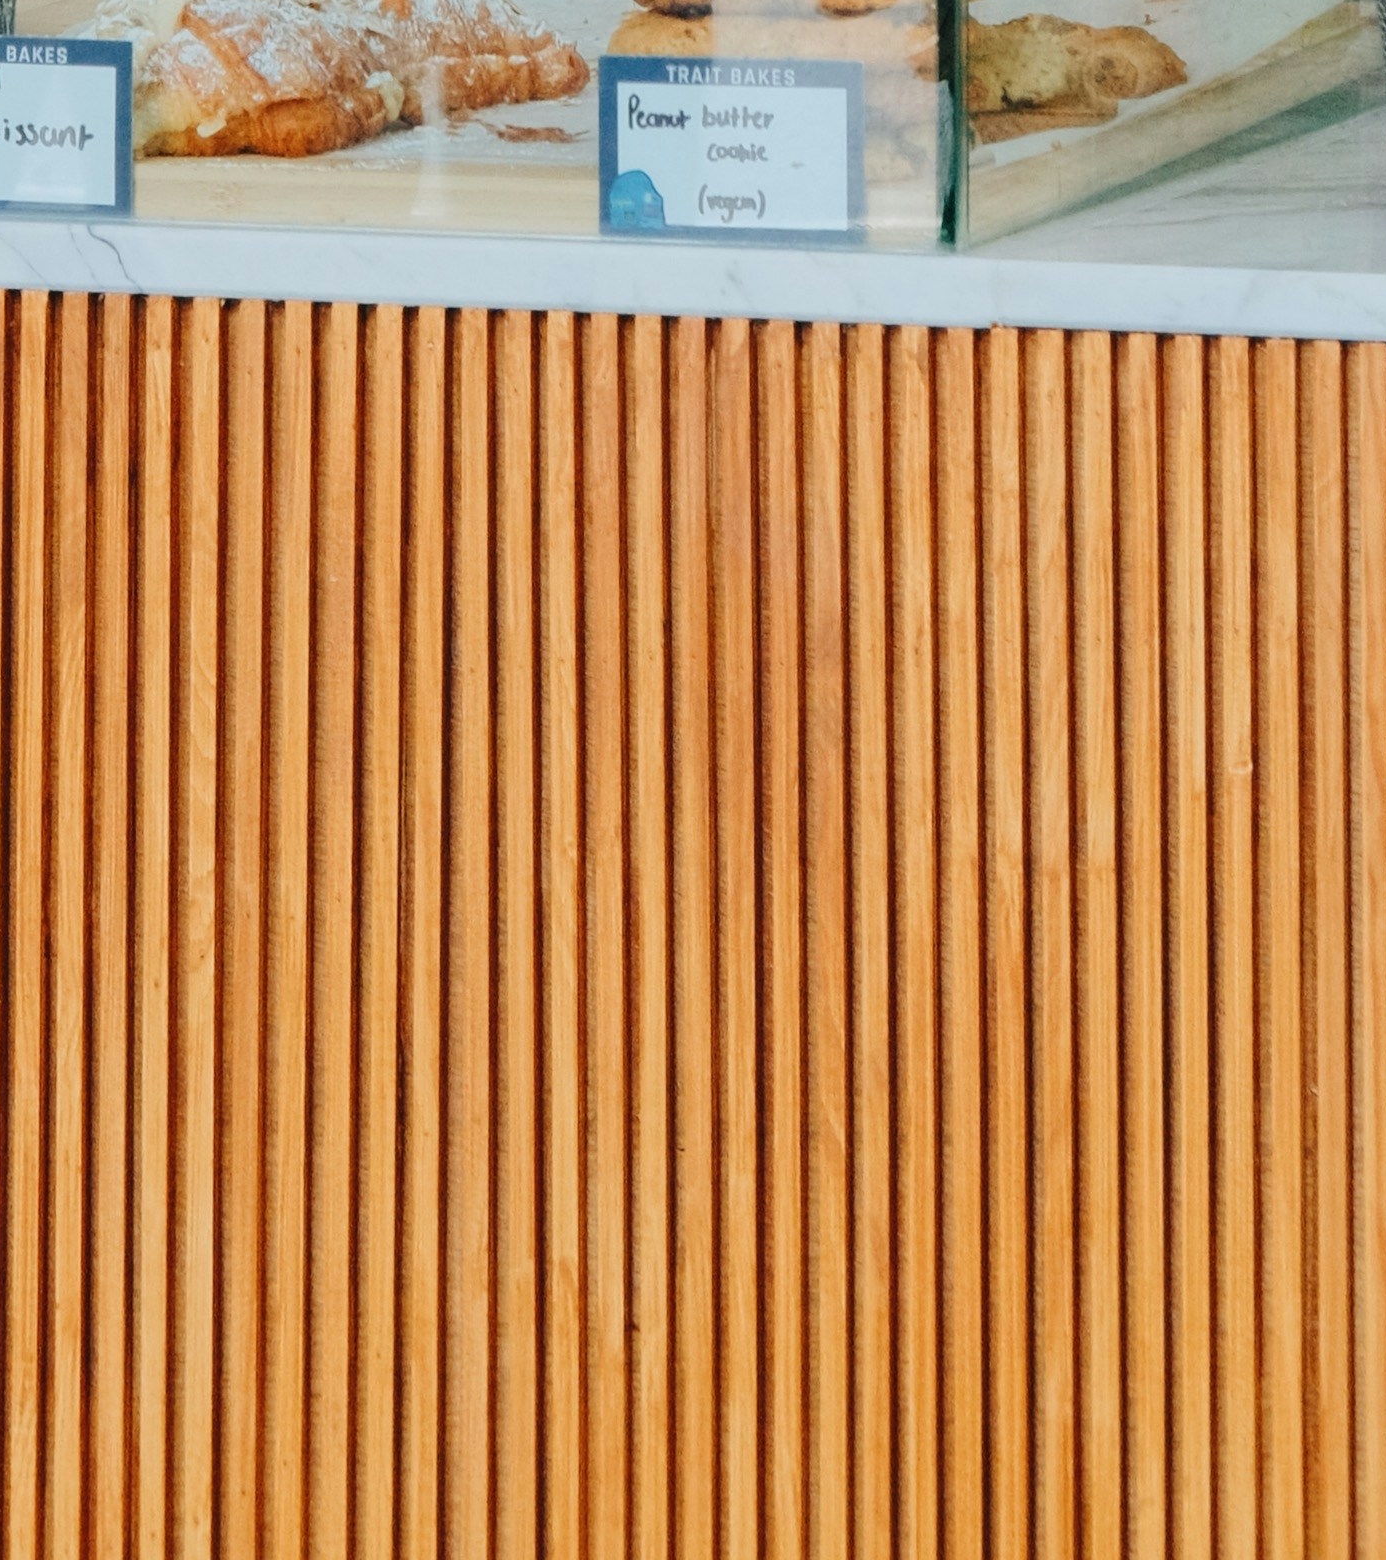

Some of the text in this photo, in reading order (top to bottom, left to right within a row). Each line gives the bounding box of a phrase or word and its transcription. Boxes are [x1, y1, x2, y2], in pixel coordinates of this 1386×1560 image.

[5, 45, 68, 64] BAKES
[666, 65, 796, 87] TRAIT BAKES
[627, 93, 775, 130] Peanut butter
[706, 142, 769, 163] cookie
[697, 183, 767, 223] (vegan)
